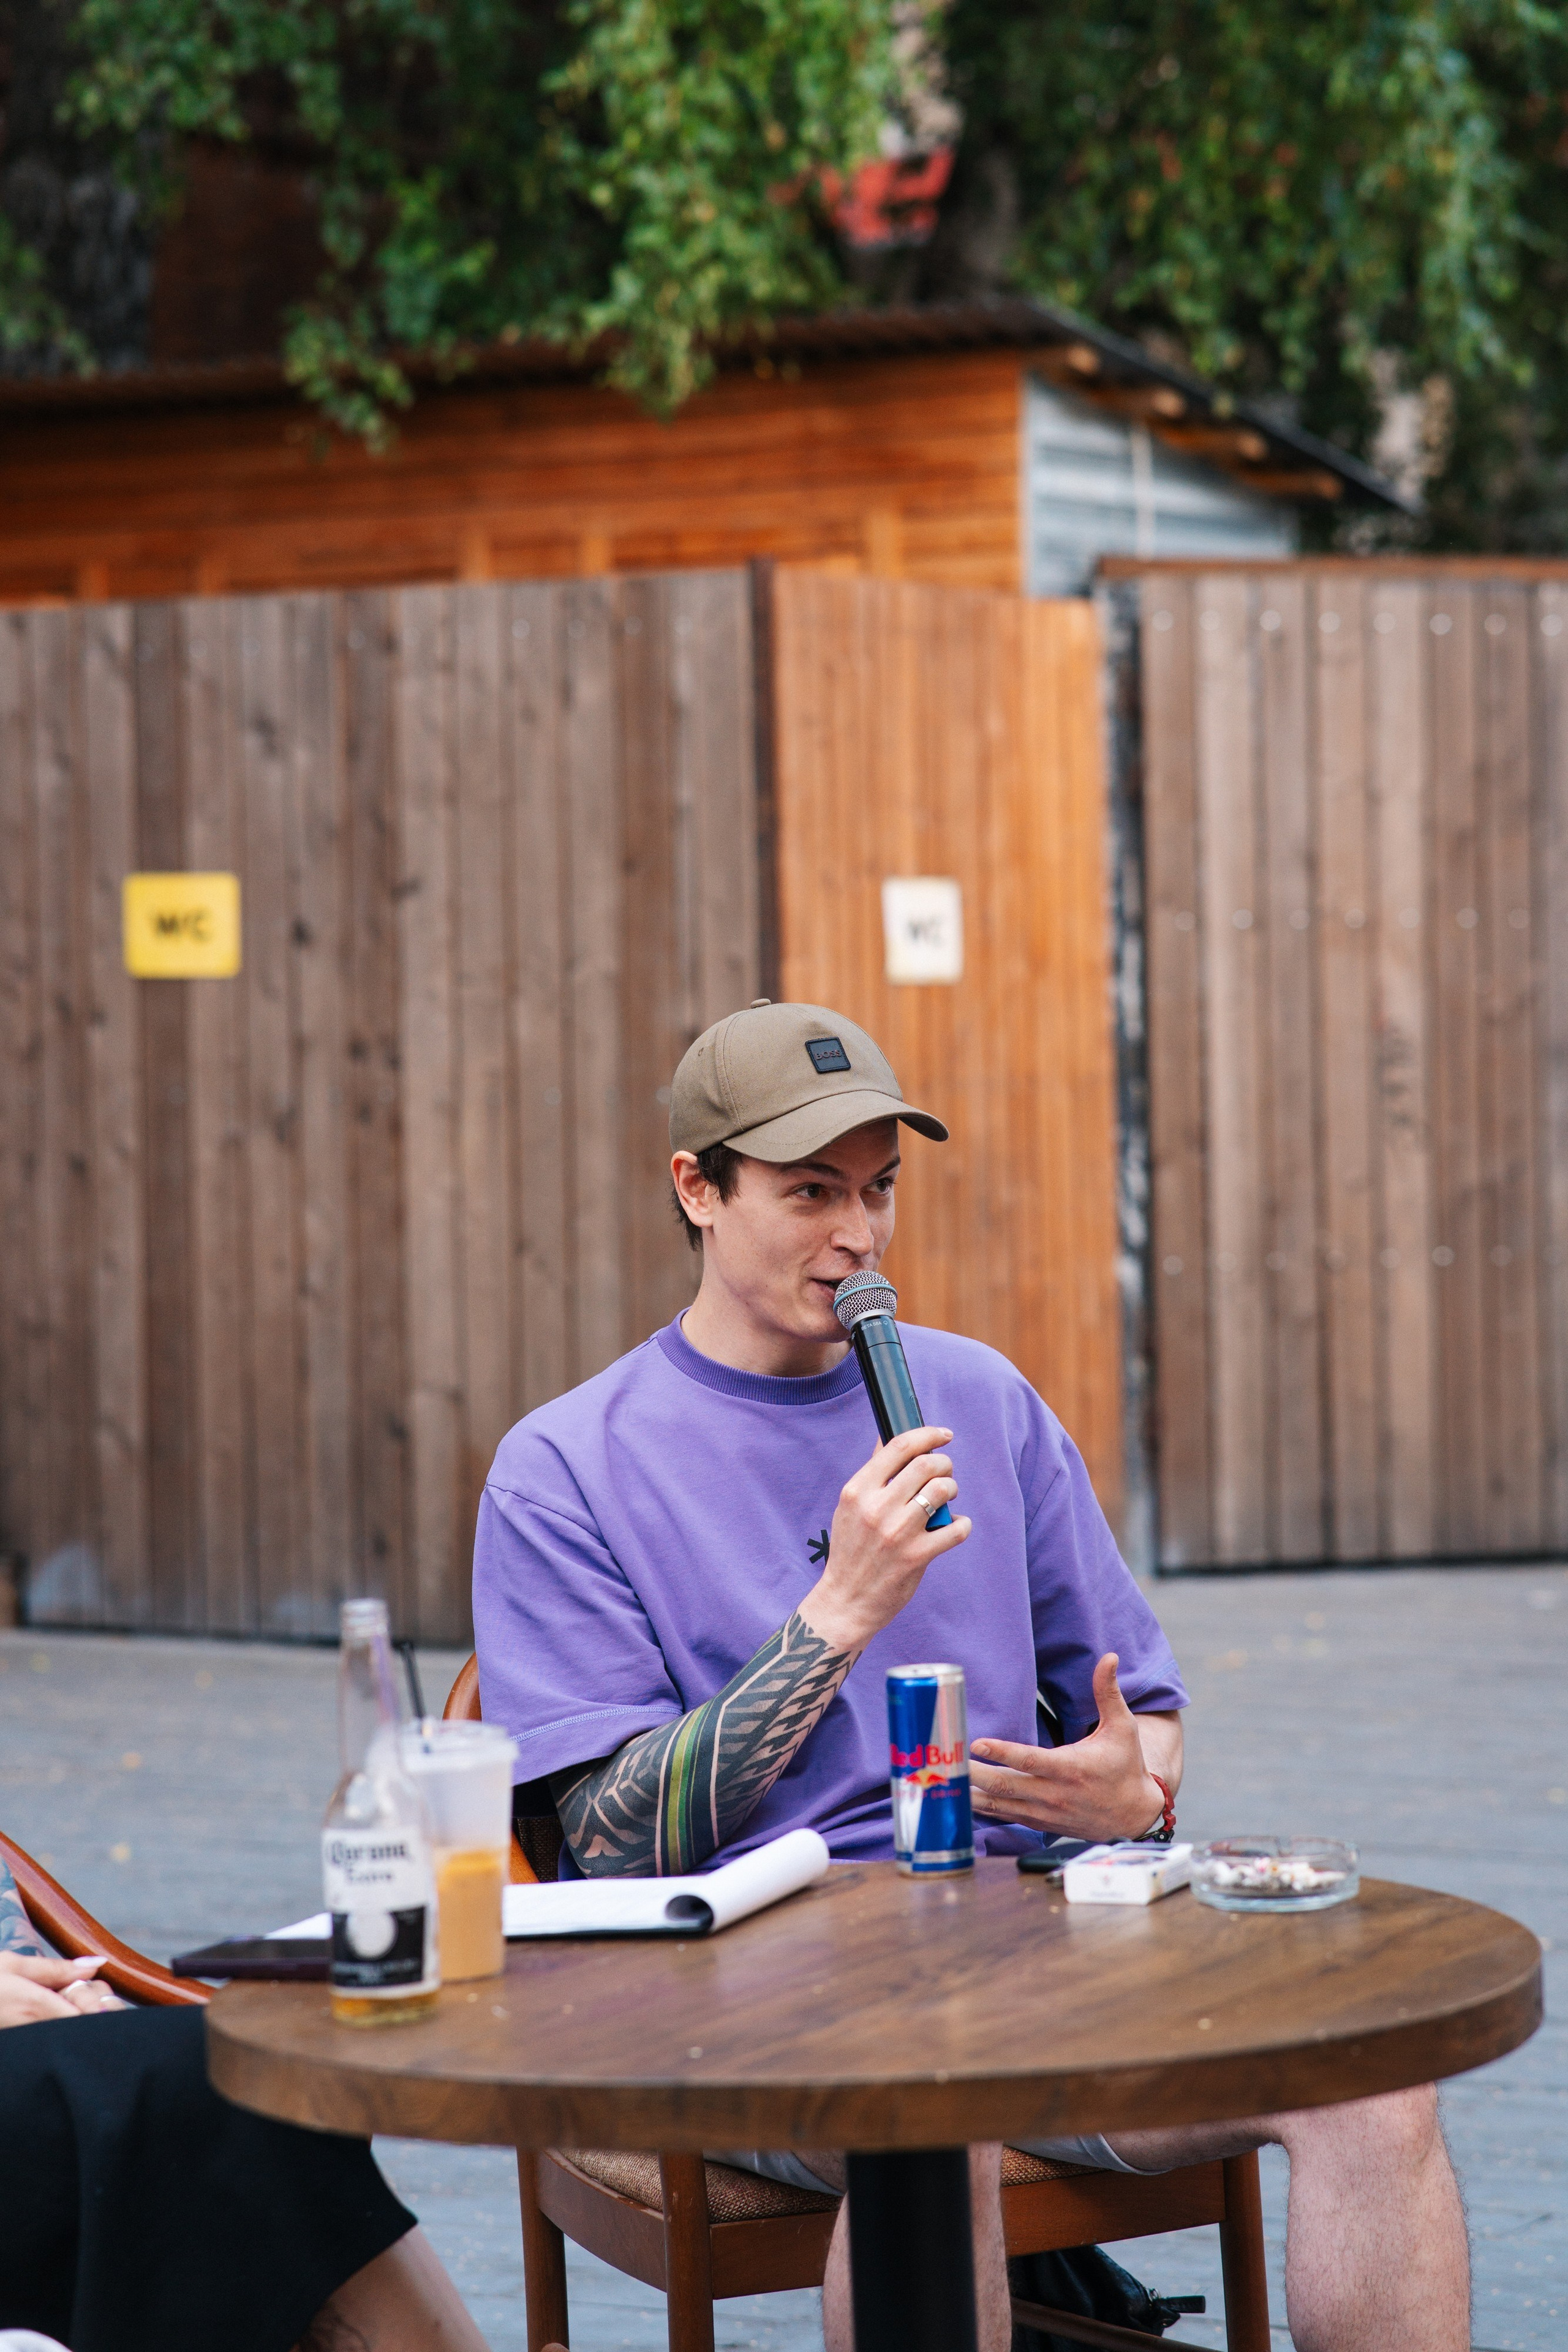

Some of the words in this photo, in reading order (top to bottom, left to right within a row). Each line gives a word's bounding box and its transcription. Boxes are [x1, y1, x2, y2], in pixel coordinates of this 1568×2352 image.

[151, 911, 213, 943] WC
[815, 1050, 840, 1060] BOSS
[925, 1742, 963, 1766] Bull
